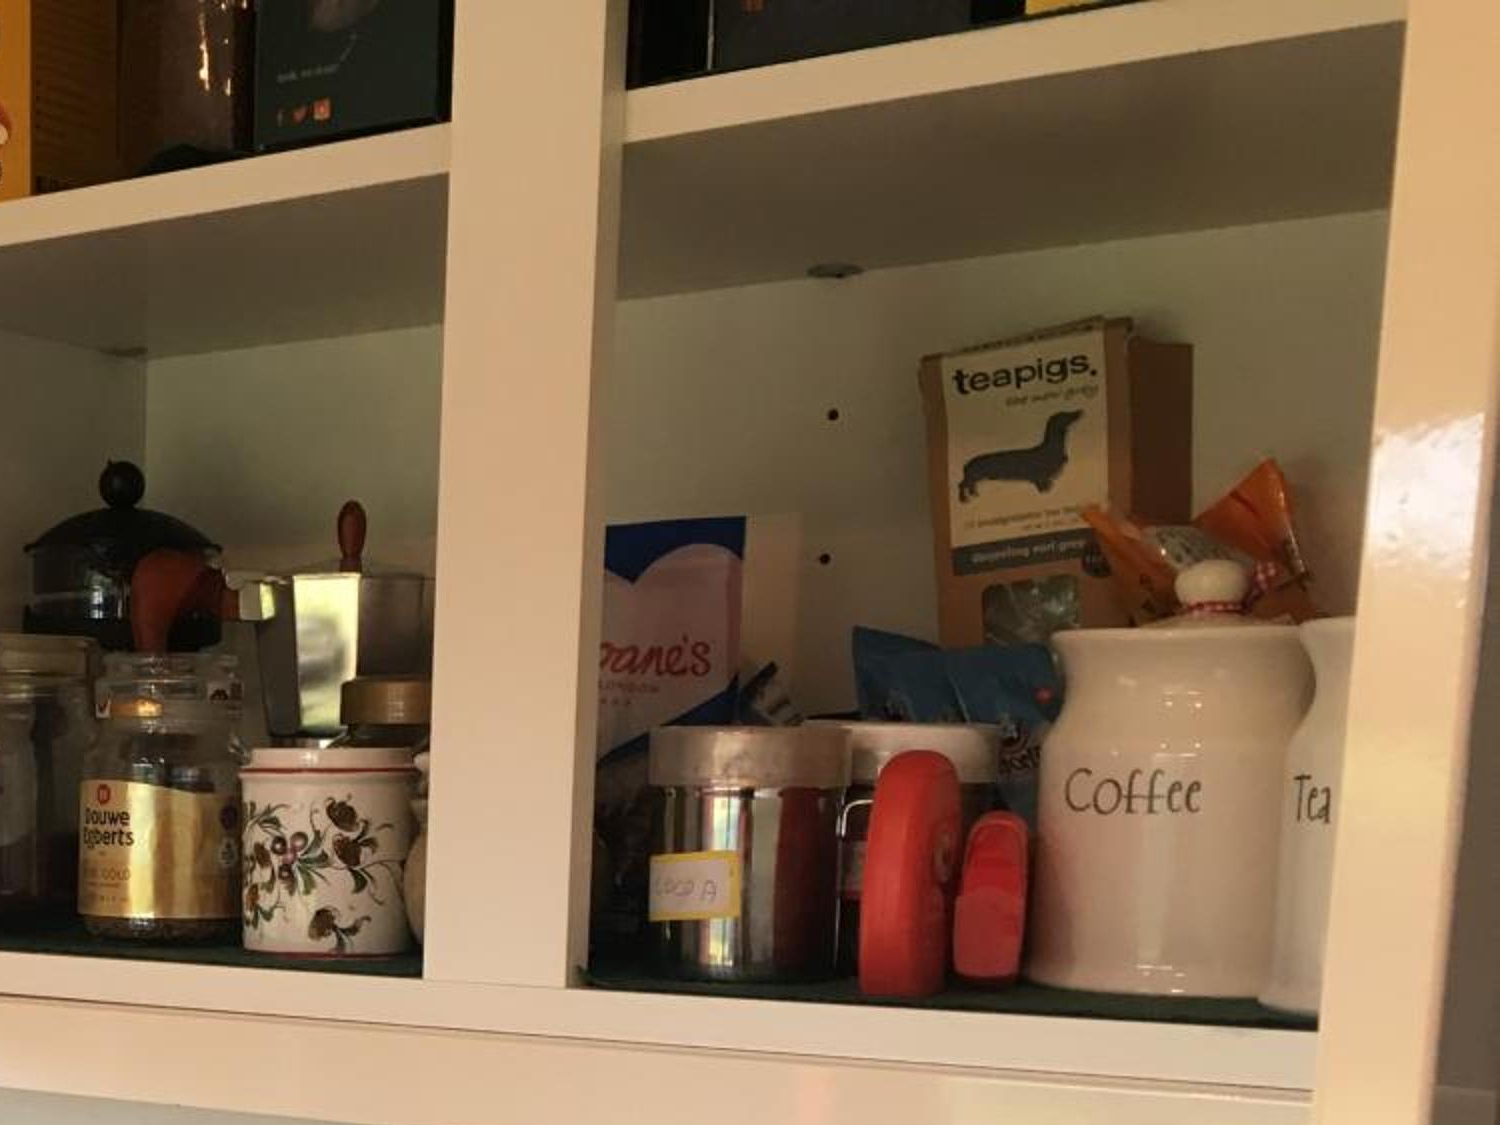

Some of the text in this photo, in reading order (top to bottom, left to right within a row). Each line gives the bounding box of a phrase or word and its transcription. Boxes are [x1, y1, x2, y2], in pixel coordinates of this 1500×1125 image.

[952, 353, 1098, 396] teapigs.
[1064, 767, 1202, 815] Coffee
[1293, 774, 1332, 824] Tea
